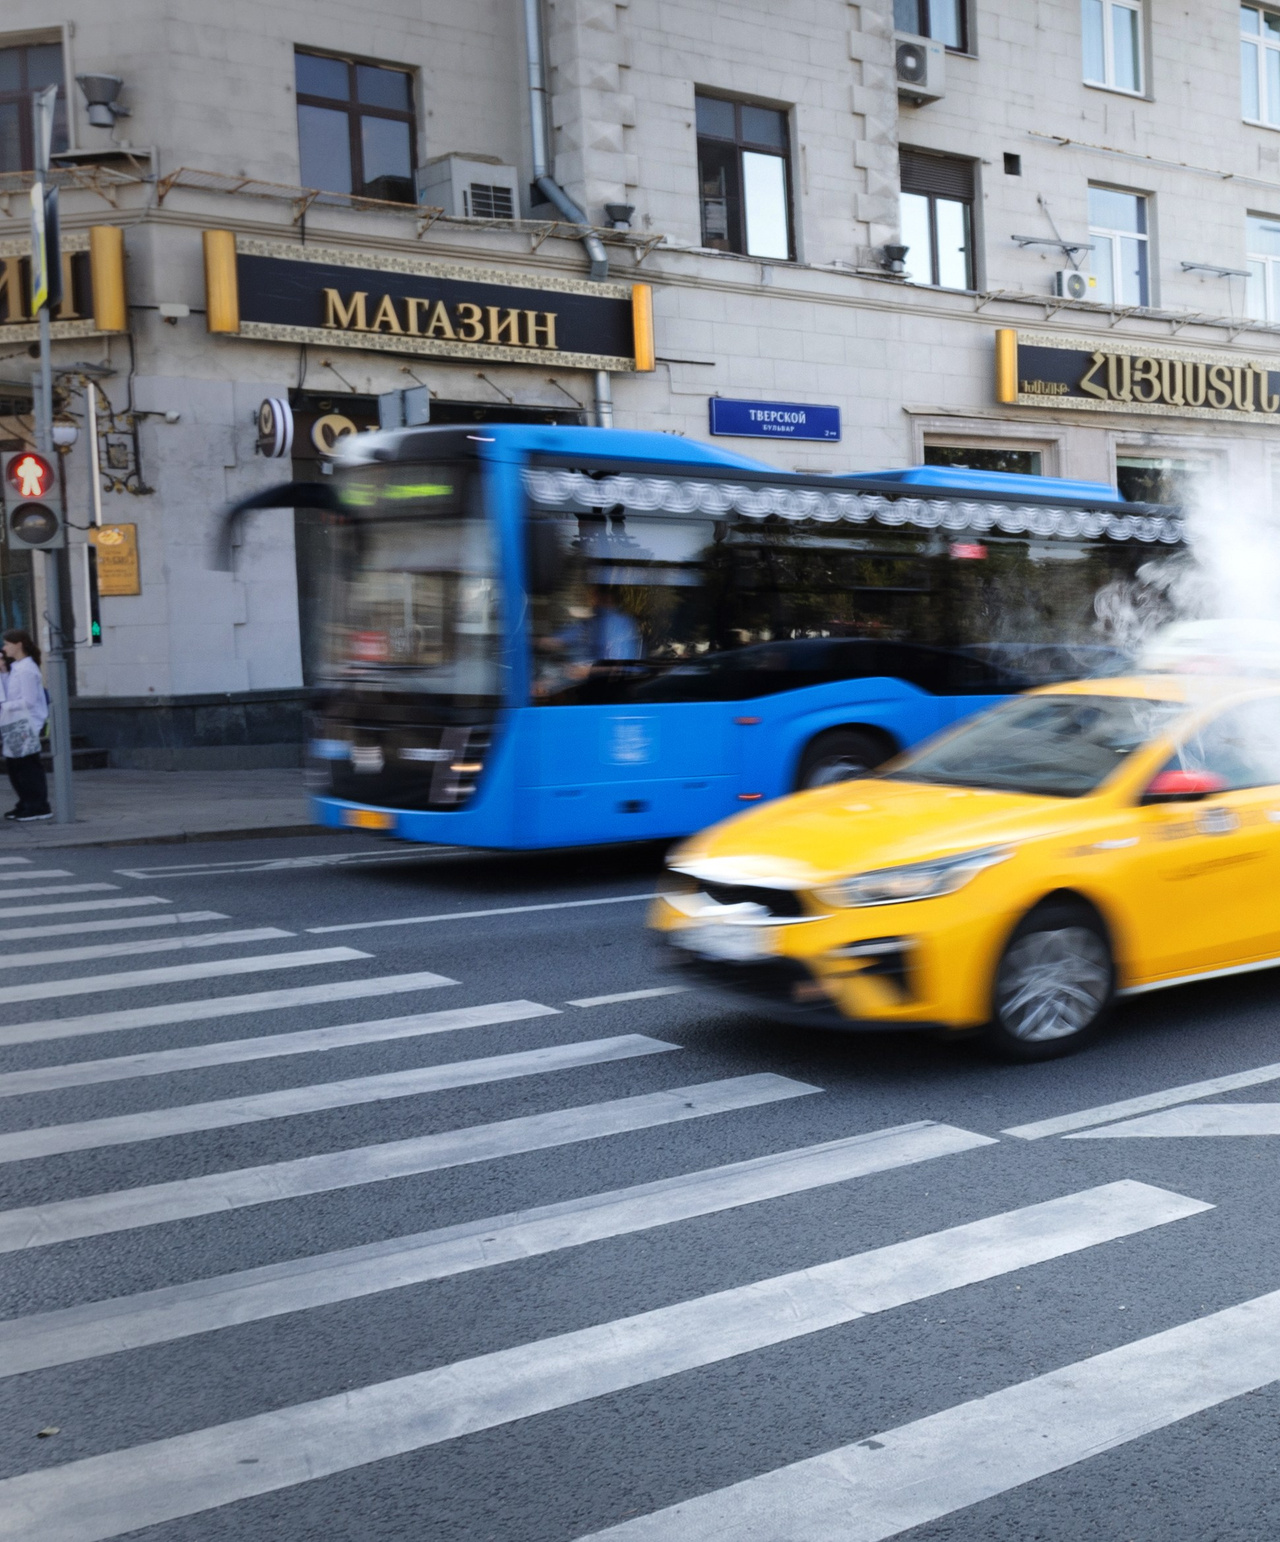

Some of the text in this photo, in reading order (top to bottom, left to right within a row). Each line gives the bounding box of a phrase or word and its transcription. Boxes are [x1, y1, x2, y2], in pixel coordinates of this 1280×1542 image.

[323, 287, 559, 350] МАГАЗИН
[748, 409, 806, 424] ТВЕРСКОЙ
[762, 424, 795, 433] БУЛЬВАР
